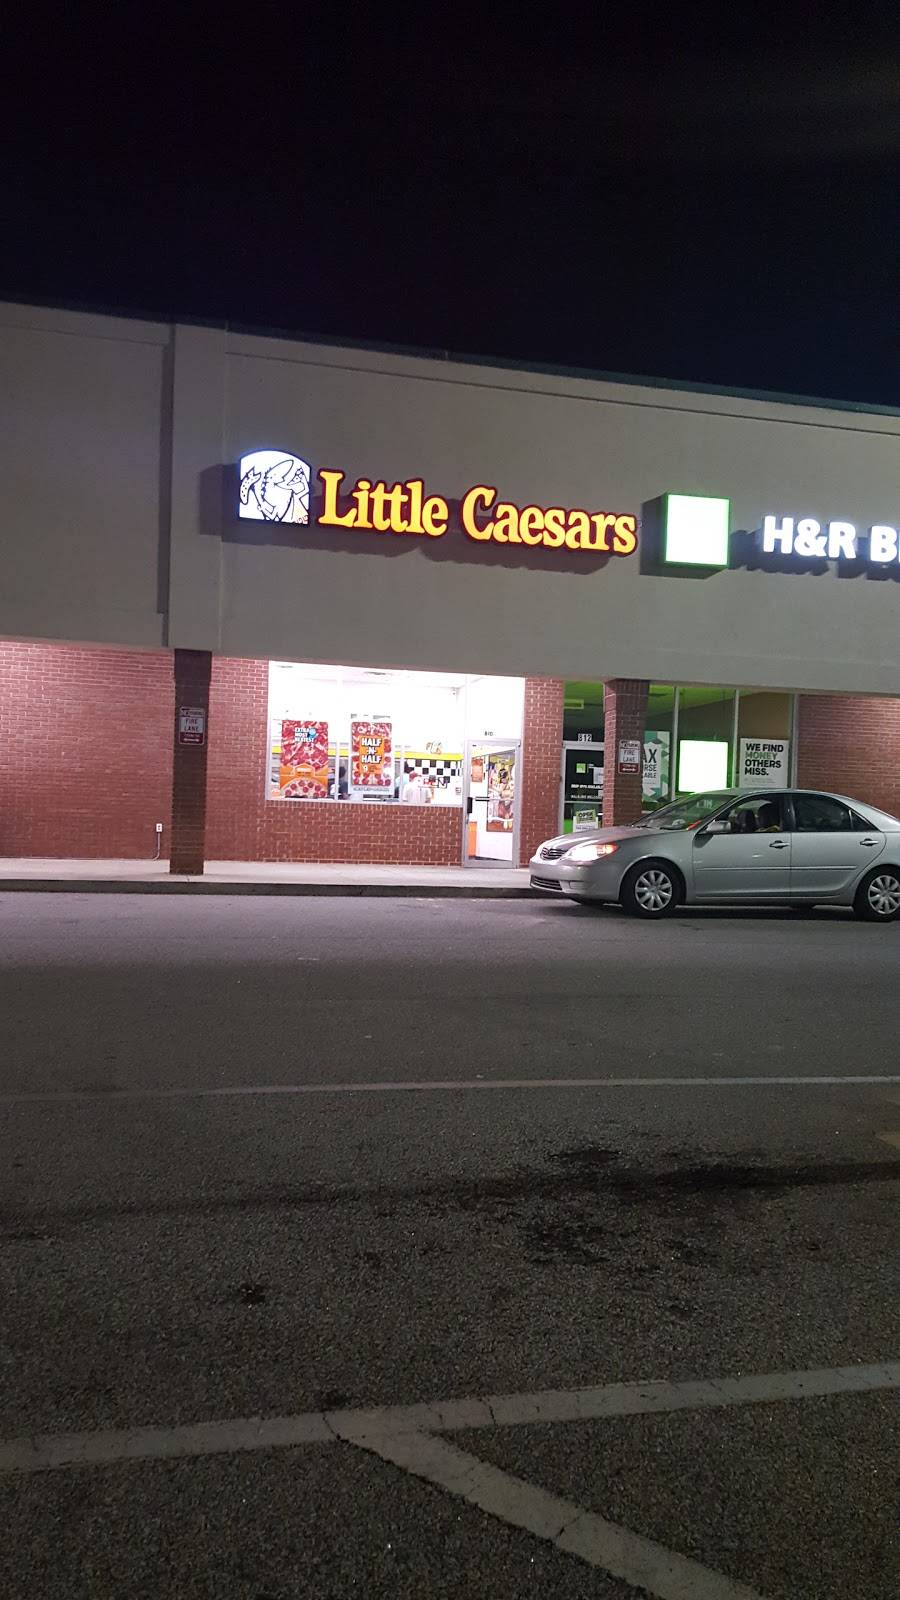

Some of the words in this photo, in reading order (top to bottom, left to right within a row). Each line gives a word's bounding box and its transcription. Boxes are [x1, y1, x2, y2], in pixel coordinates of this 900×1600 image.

[317, 469, 449, 537] Little
[461, 485, 638, 554] Caesars
[762, 515, 857, 559] H&R
[869, 525, 900, 563] B
[361, 737, 382, 747] HALF
[578, 733, 592, 742] 812
[746, 743, 761, 751] WE
[763, 744, 784, 752] FIND
[361, 754, 382, 765] HALF
[745, 752, 777, 760] MONEY
[745, 759, 782, 768] OTHERS
[744, 767, 769, 775] MISS.
